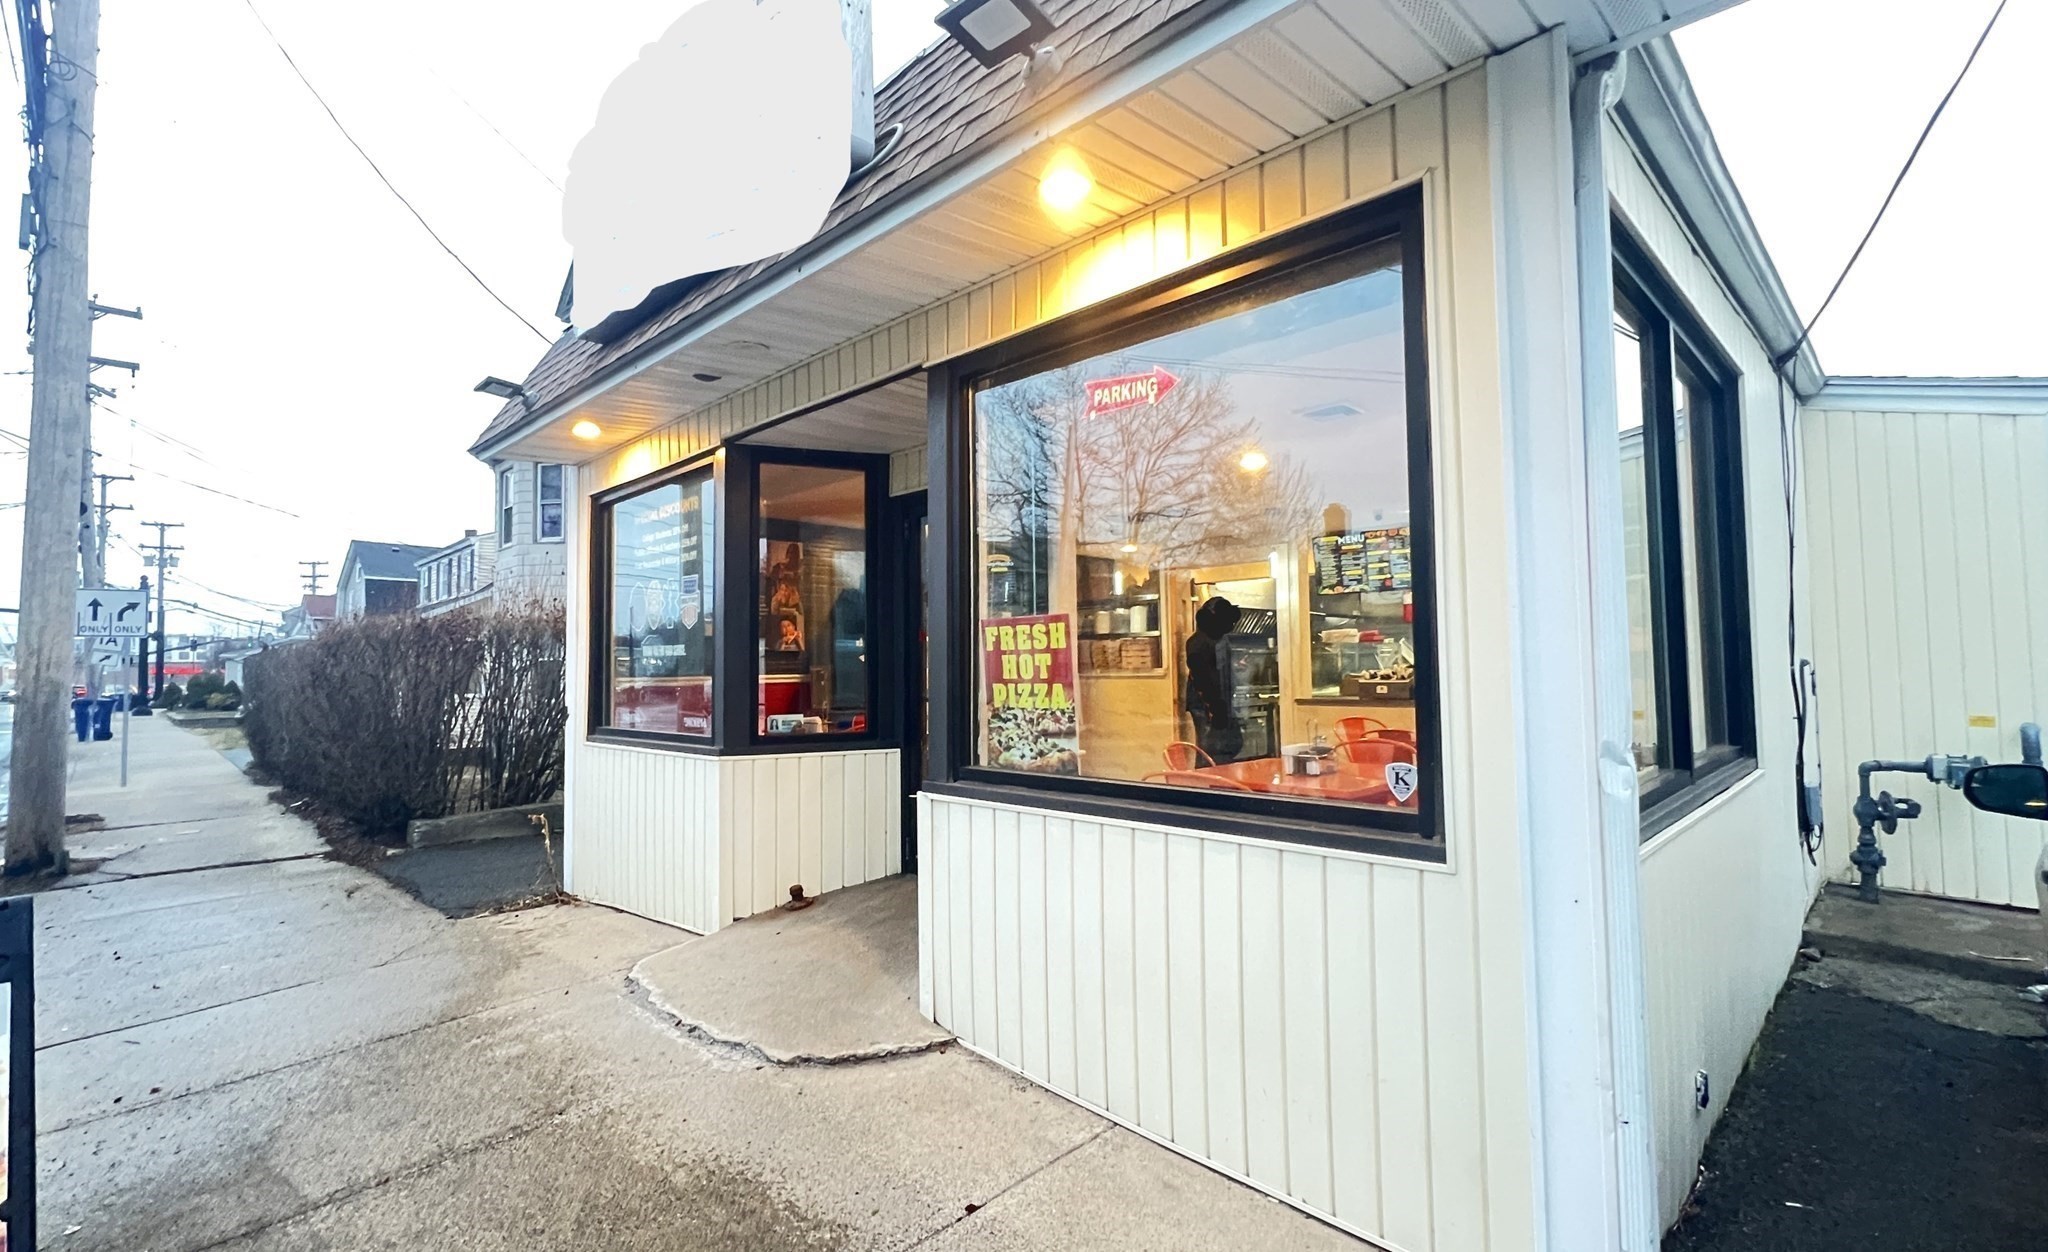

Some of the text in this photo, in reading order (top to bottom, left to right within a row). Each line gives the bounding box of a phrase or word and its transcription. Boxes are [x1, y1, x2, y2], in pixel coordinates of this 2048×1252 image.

[1093, 377, 1158, 407] PARKING
[1337, 534, 1365, 545] MENU
[80, 625, 142, 633] ONLY ONLY
[984, 622, 1067, 651] FRESH
[1001, 653, 1052, 680] HOT
[992, 682, 1069, 709] PIZZA
[1394, 771, 1411, 787] K
